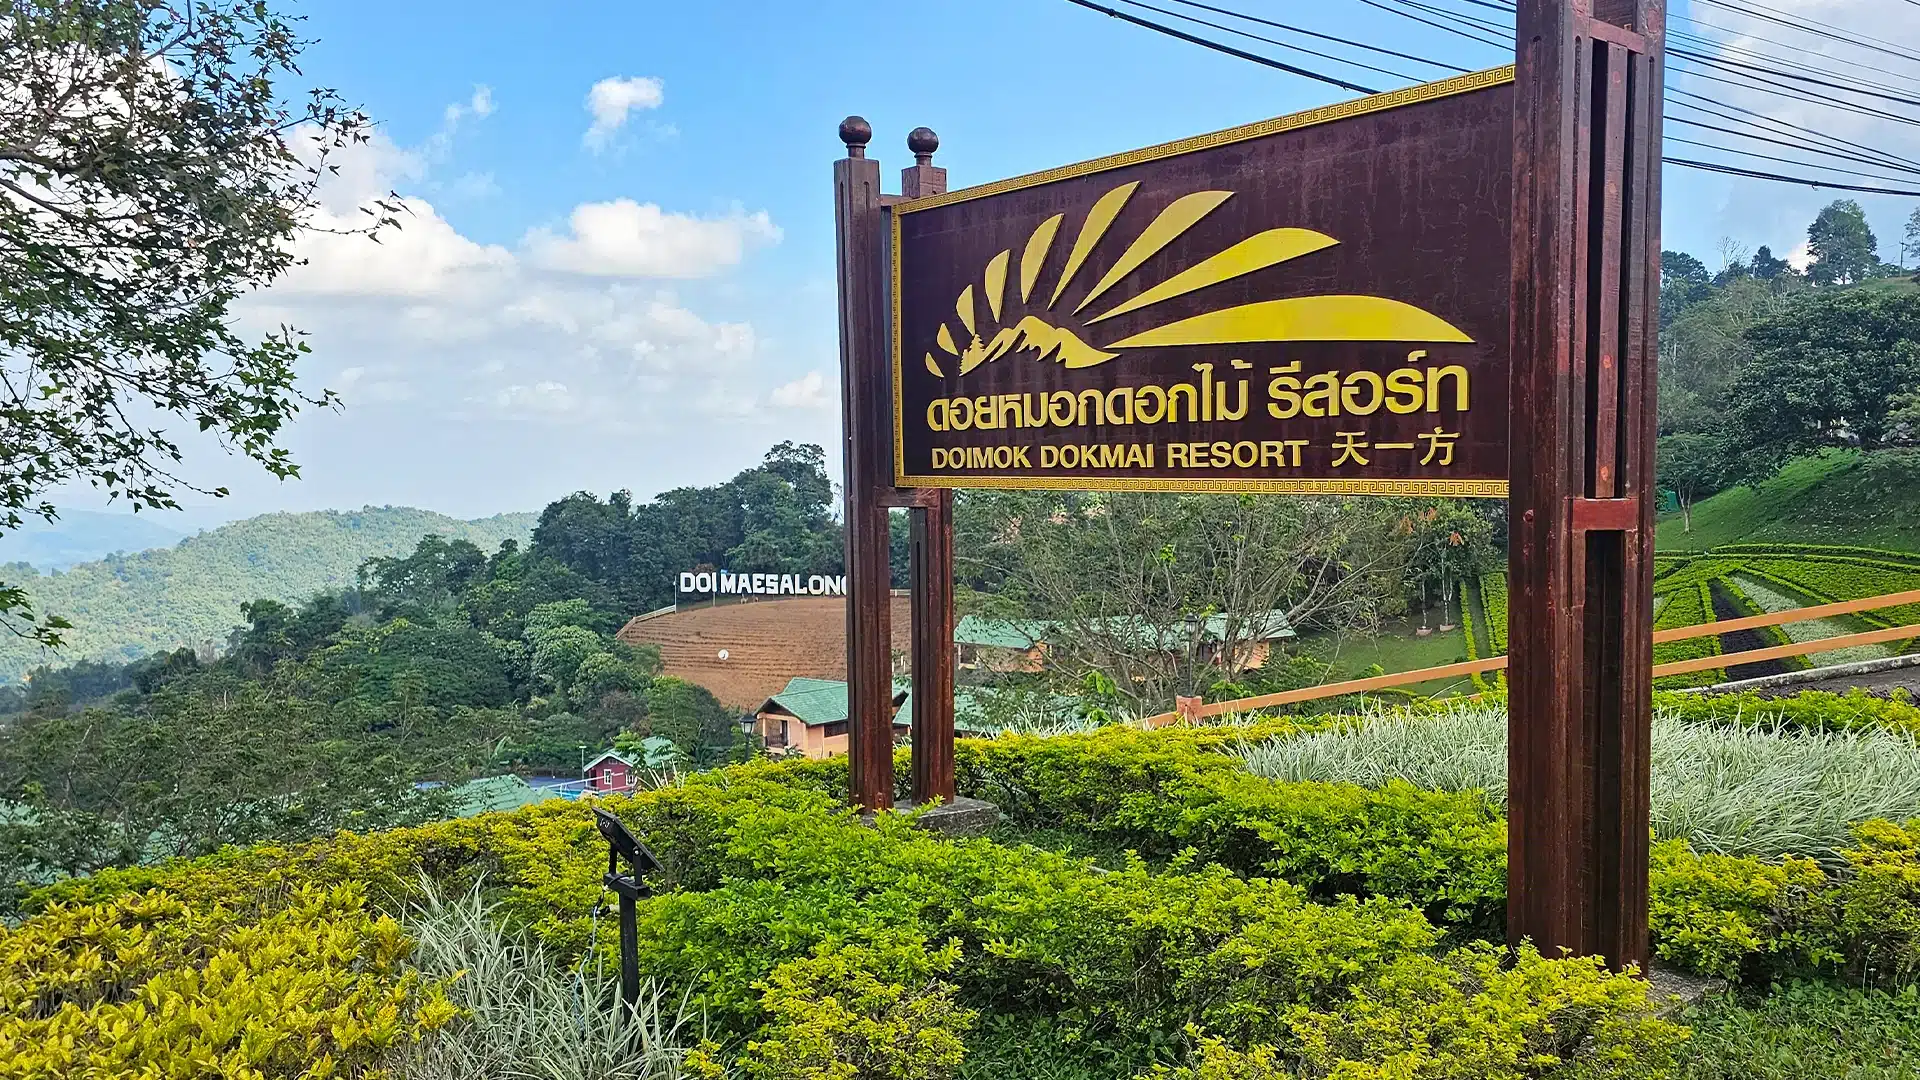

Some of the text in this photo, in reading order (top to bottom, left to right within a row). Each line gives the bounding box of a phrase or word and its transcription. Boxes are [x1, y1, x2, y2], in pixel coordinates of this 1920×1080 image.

[926, 350, 1470, 432] ดอยหมอกดอกไม้ รีสอร์ท
[931, 440, 1309, 469] DOIMOK DOKMAI RESORT
[1331, 427, 1461, 467] 天一方
[680, 572, 718, 593] DOI
